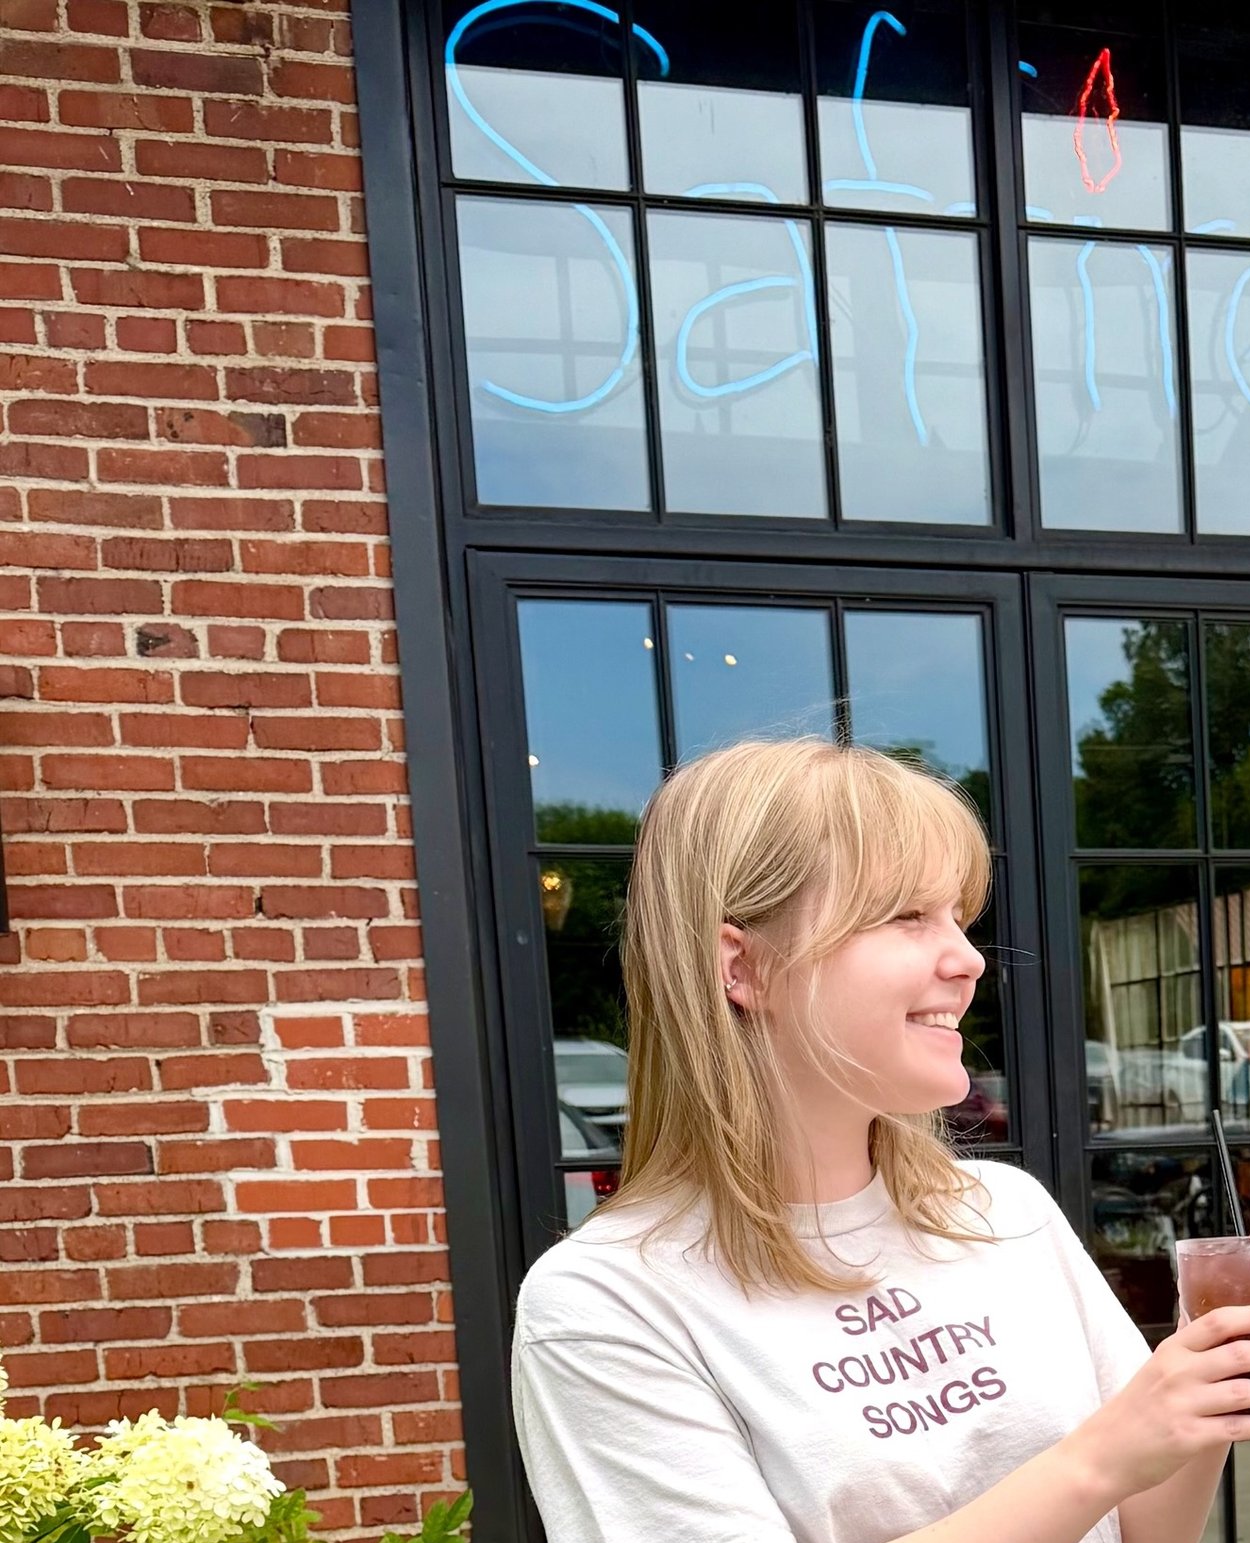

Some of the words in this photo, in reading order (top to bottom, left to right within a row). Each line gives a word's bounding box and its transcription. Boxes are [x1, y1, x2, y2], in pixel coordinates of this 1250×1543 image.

[835, 1288, 922, 1335] SAD
[812, 1316, 997, 1393] COUNTRY
[863, 1366, 1007, 1439] SONGS
